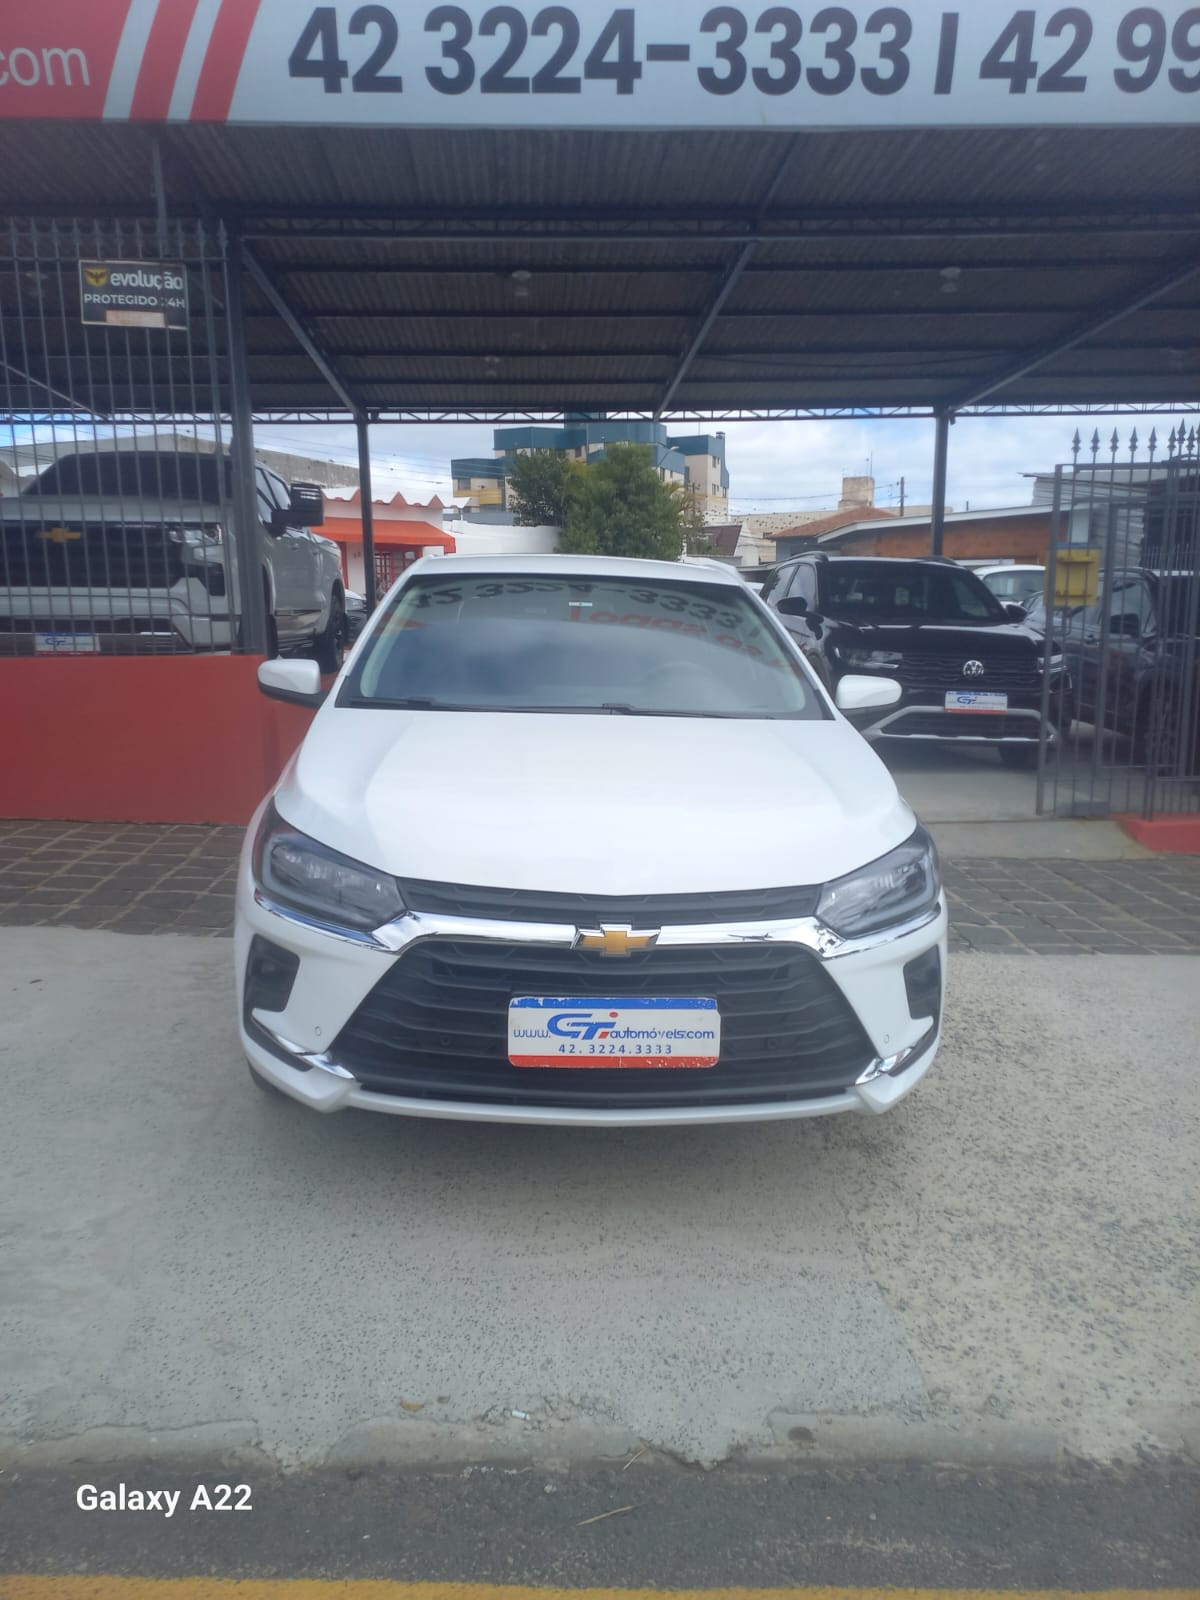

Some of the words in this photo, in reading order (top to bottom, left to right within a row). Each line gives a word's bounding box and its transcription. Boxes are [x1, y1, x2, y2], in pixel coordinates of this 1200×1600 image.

[288, 5, 403, 93] 42
[423, 5, 912, 95] 3224-3333
[979, 7, 1093, 94] 42
[110, 270, 183, 290] evolução
[83, 293, 158, 306] PROTEGIDO
[161, 297, 185, 308] 4H
